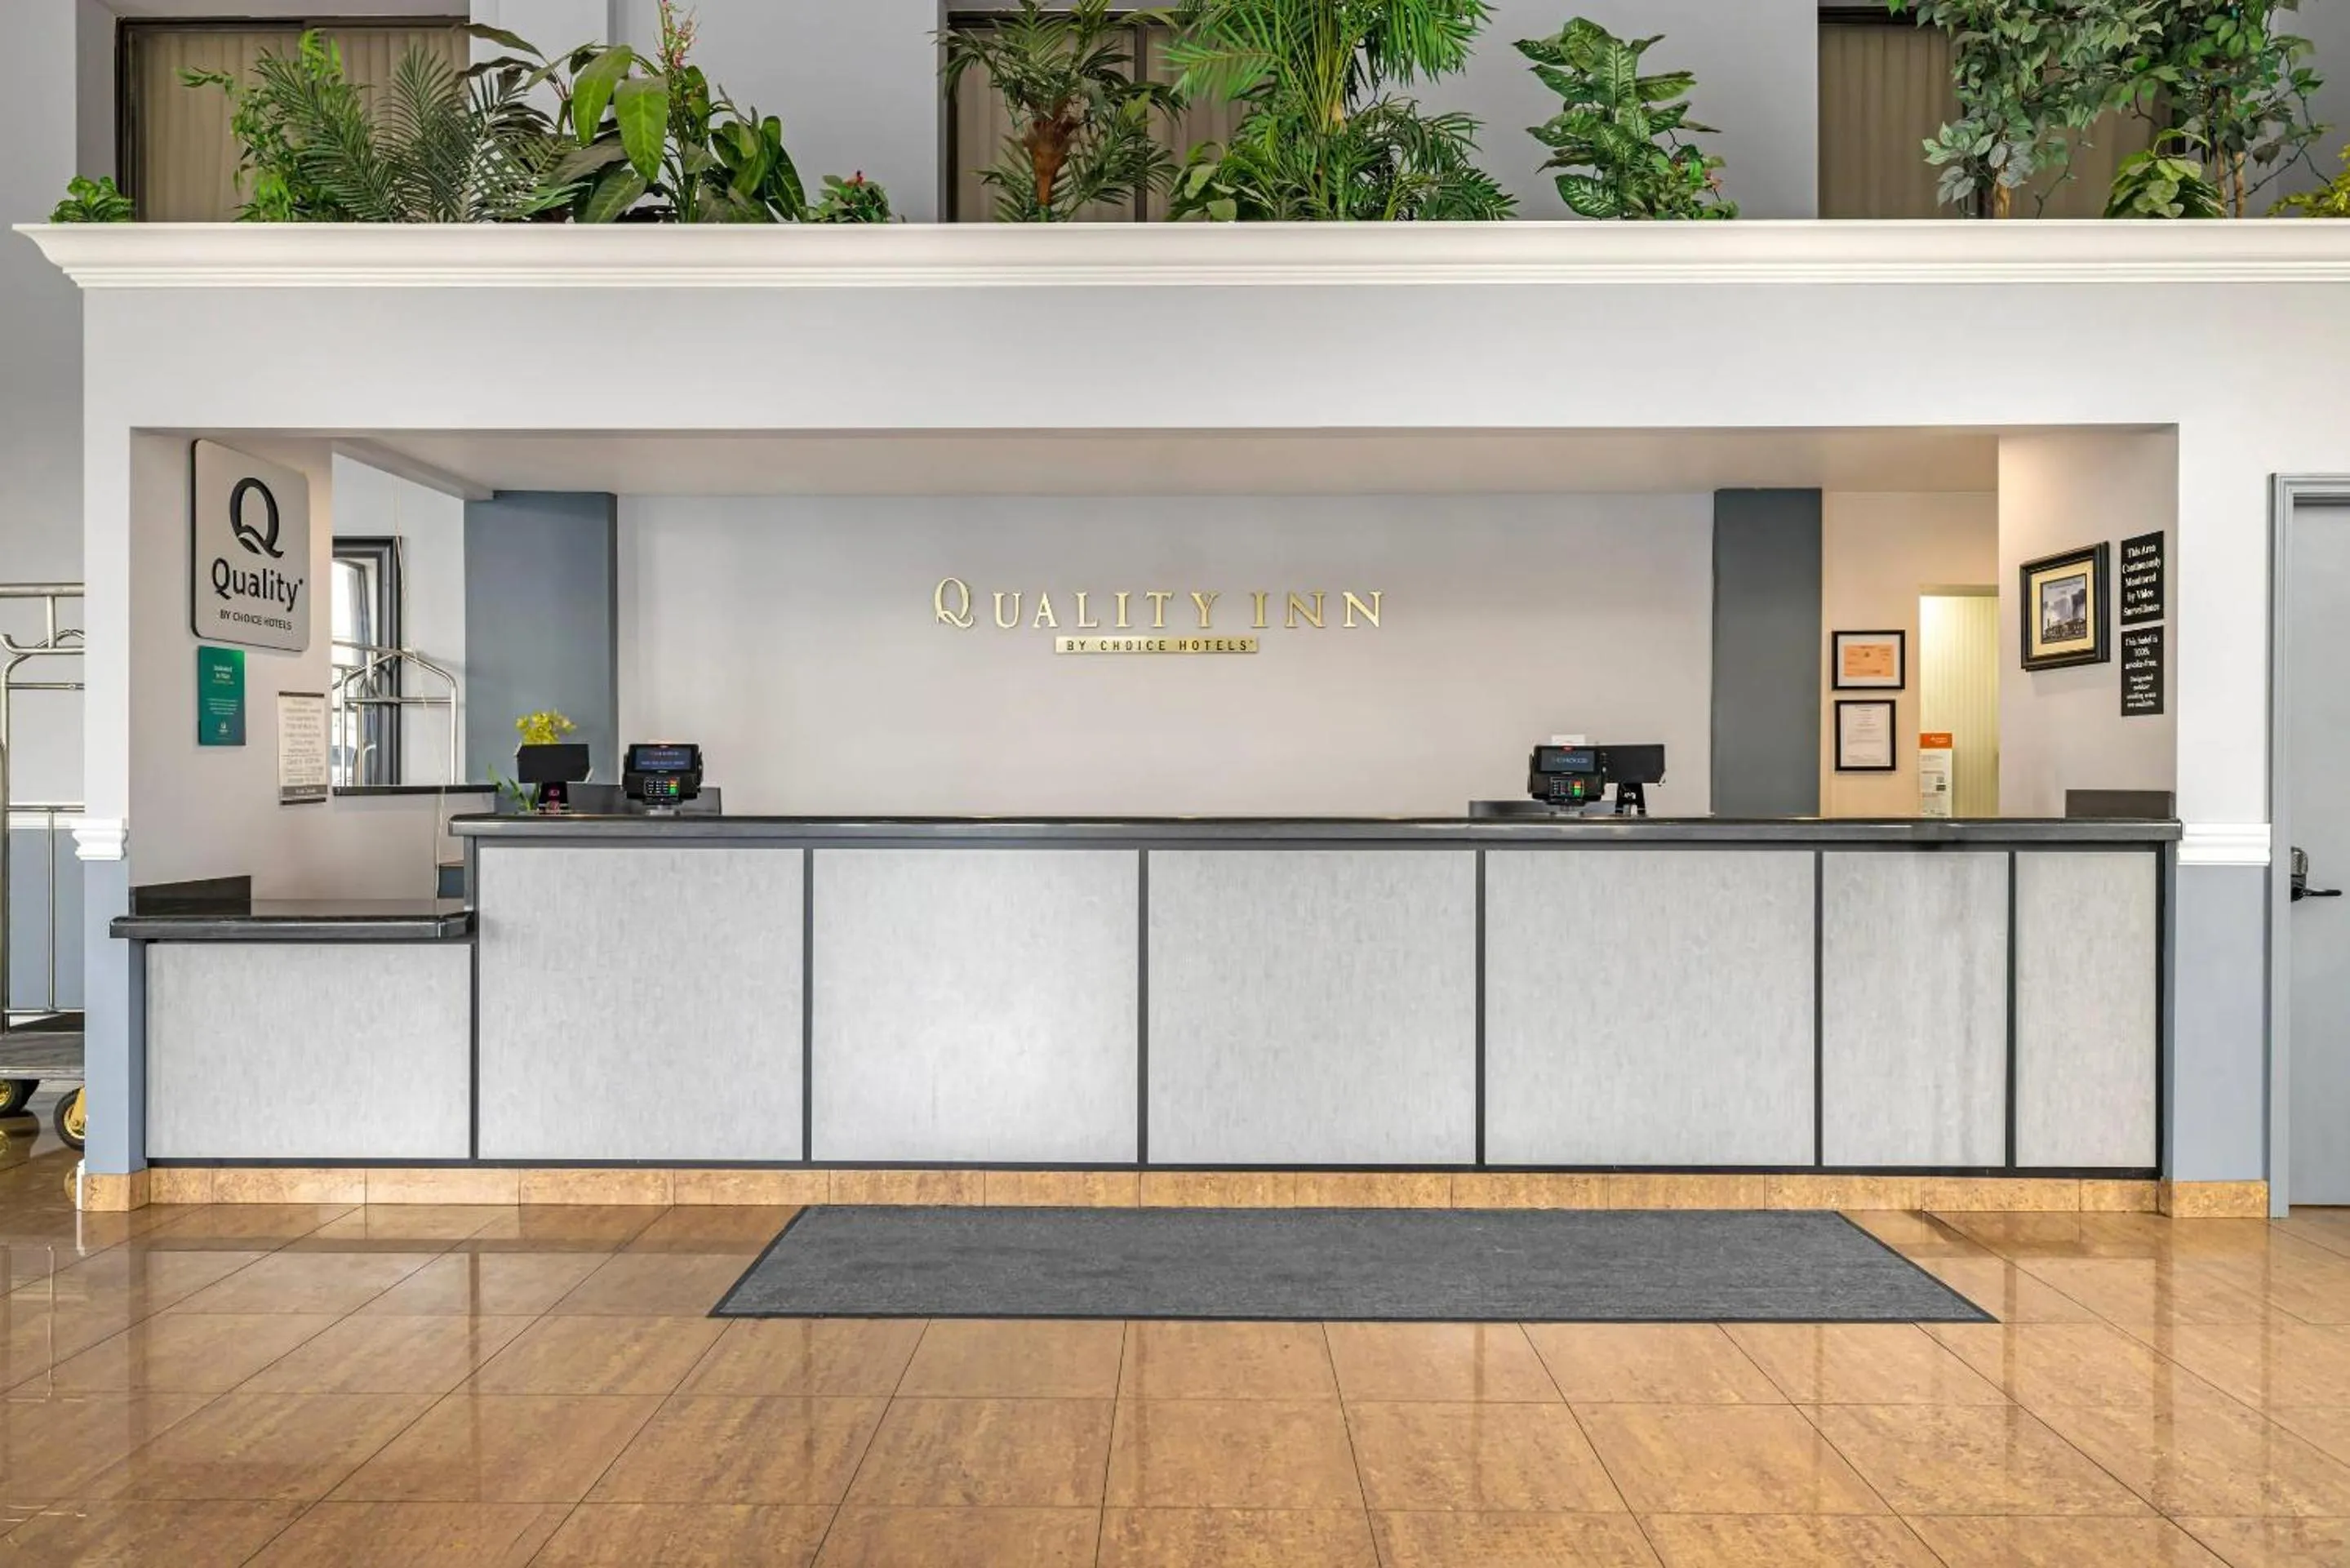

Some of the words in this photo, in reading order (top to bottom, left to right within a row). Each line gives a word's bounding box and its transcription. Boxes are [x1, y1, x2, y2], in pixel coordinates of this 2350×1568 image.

[229, 477, 284, 558] Q
[2127, 548, 2140, 558] This
[2141, 544, 2157, 555] Area
[933, 577, 1220, 629] QUALITY
[1251, 590, 1384, 628] INN
[2136, 588, 2154, 600] Video
[220, 609, 232, 621] BY
[233, 611, 263, 626] CHOICE
[264, 616, 293, 631] HOTELS
[1066, 639, 1086, 651] BY
[1099, 639, 1166, 651] CHOICE
